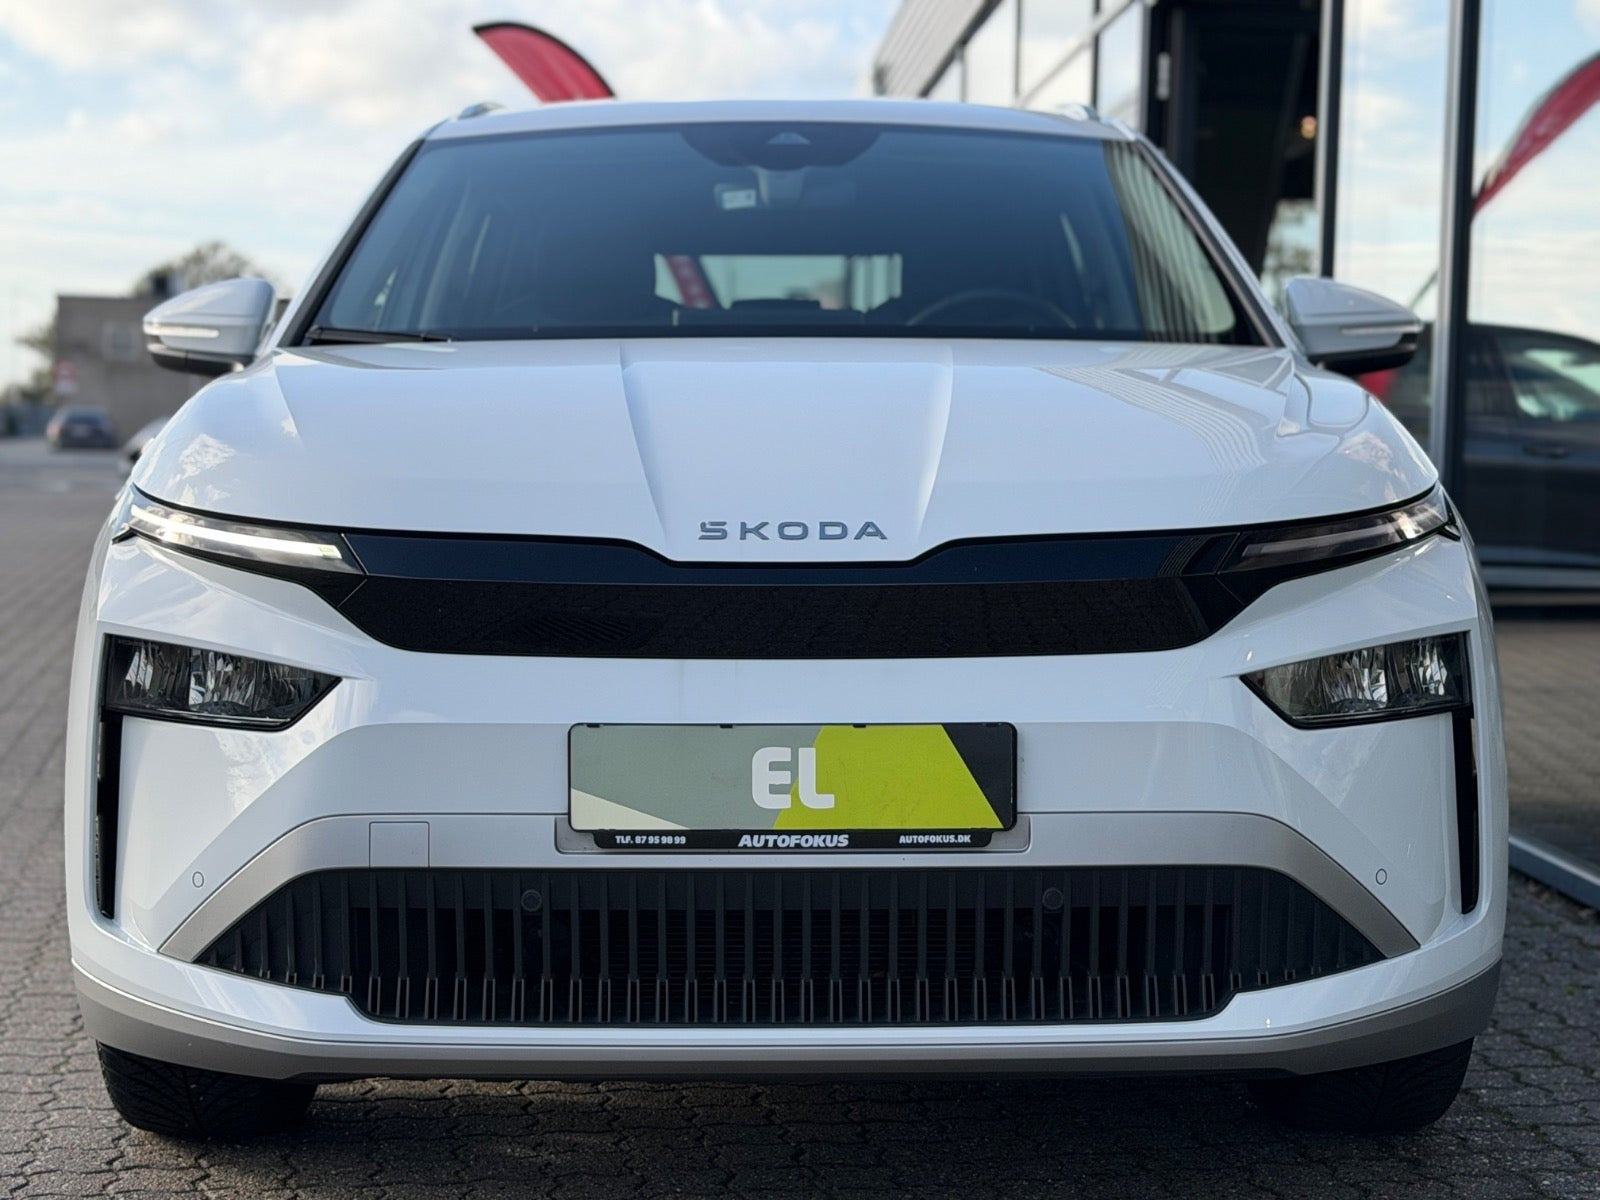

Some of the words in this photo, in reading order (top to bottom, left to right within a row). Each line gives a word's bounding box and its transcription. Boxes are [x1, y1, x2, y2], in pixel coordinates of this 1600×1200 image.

[752, 747, 835, 809] EL
[615, 835, 634, 844] TLF.
[635, 835, 647, 844] 87
[648, 835, 660, 844] 95
[661, 835, 673, 844] 98
[674, 835, 686, 844] 99
[738, 835, 849, 847] AUTOFOKUS
[899, 834, 971, 844] AUTOFOKUS.DK
